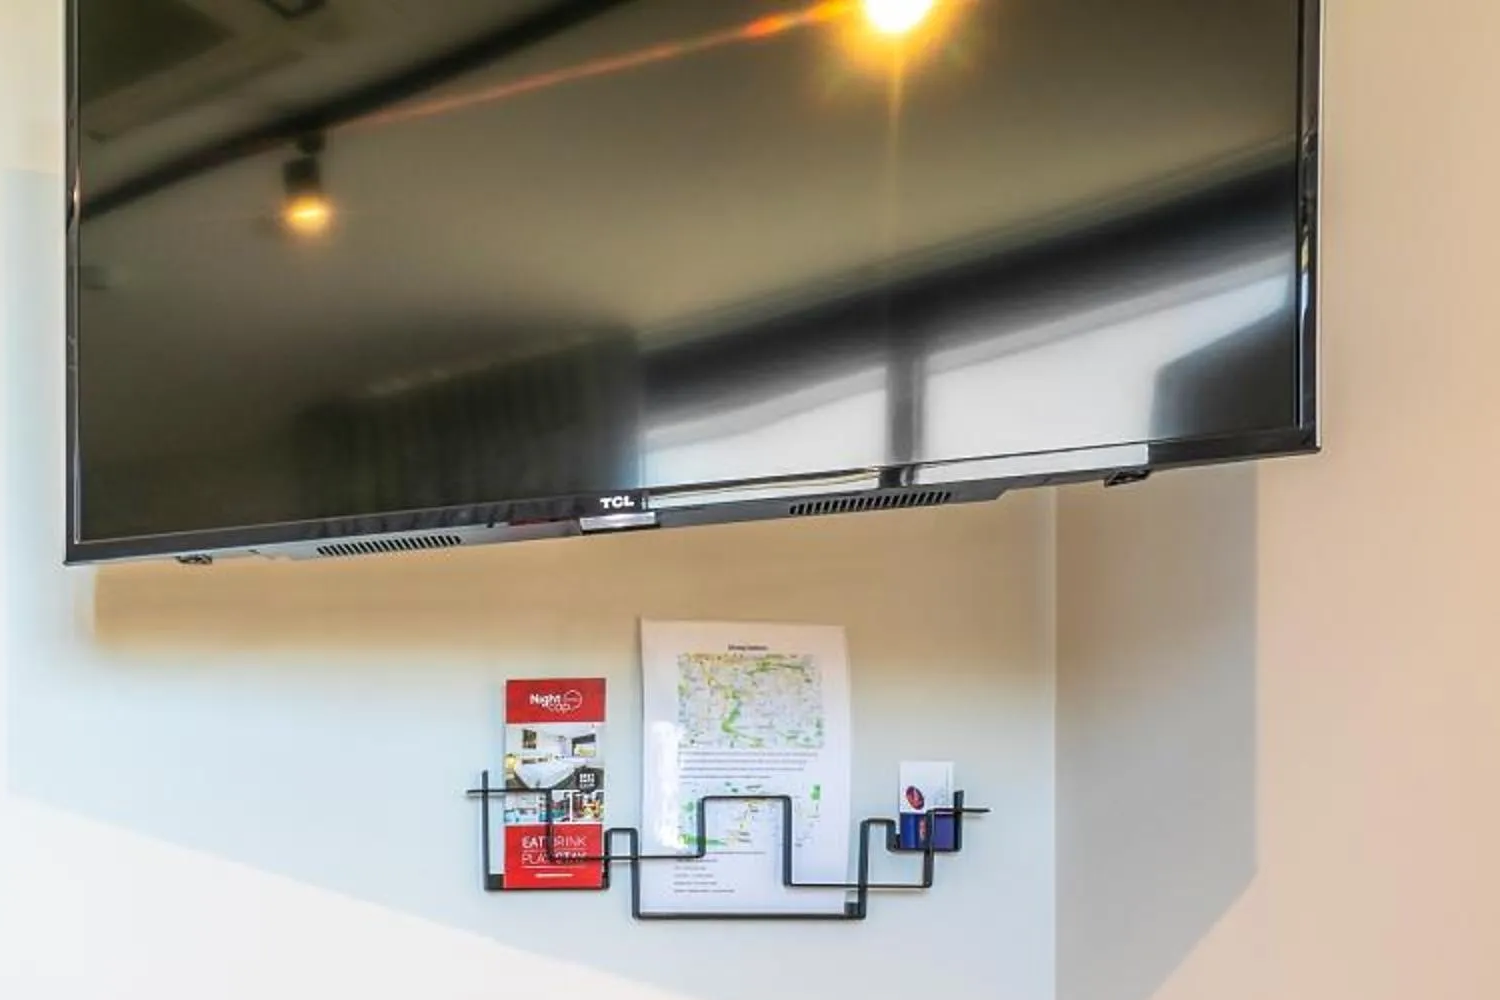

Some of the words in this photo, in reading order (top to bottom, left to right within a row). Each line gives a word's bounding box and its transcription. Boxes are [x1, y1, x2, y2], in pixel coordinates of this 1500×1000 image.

[599, 496, 635, 509] TCL
[529, 694, 561, 708] Night
[521, 835, 546, 849] EAT
[551, 835, 587, 847] RINK
[521, 853, 548, 865] PLA
